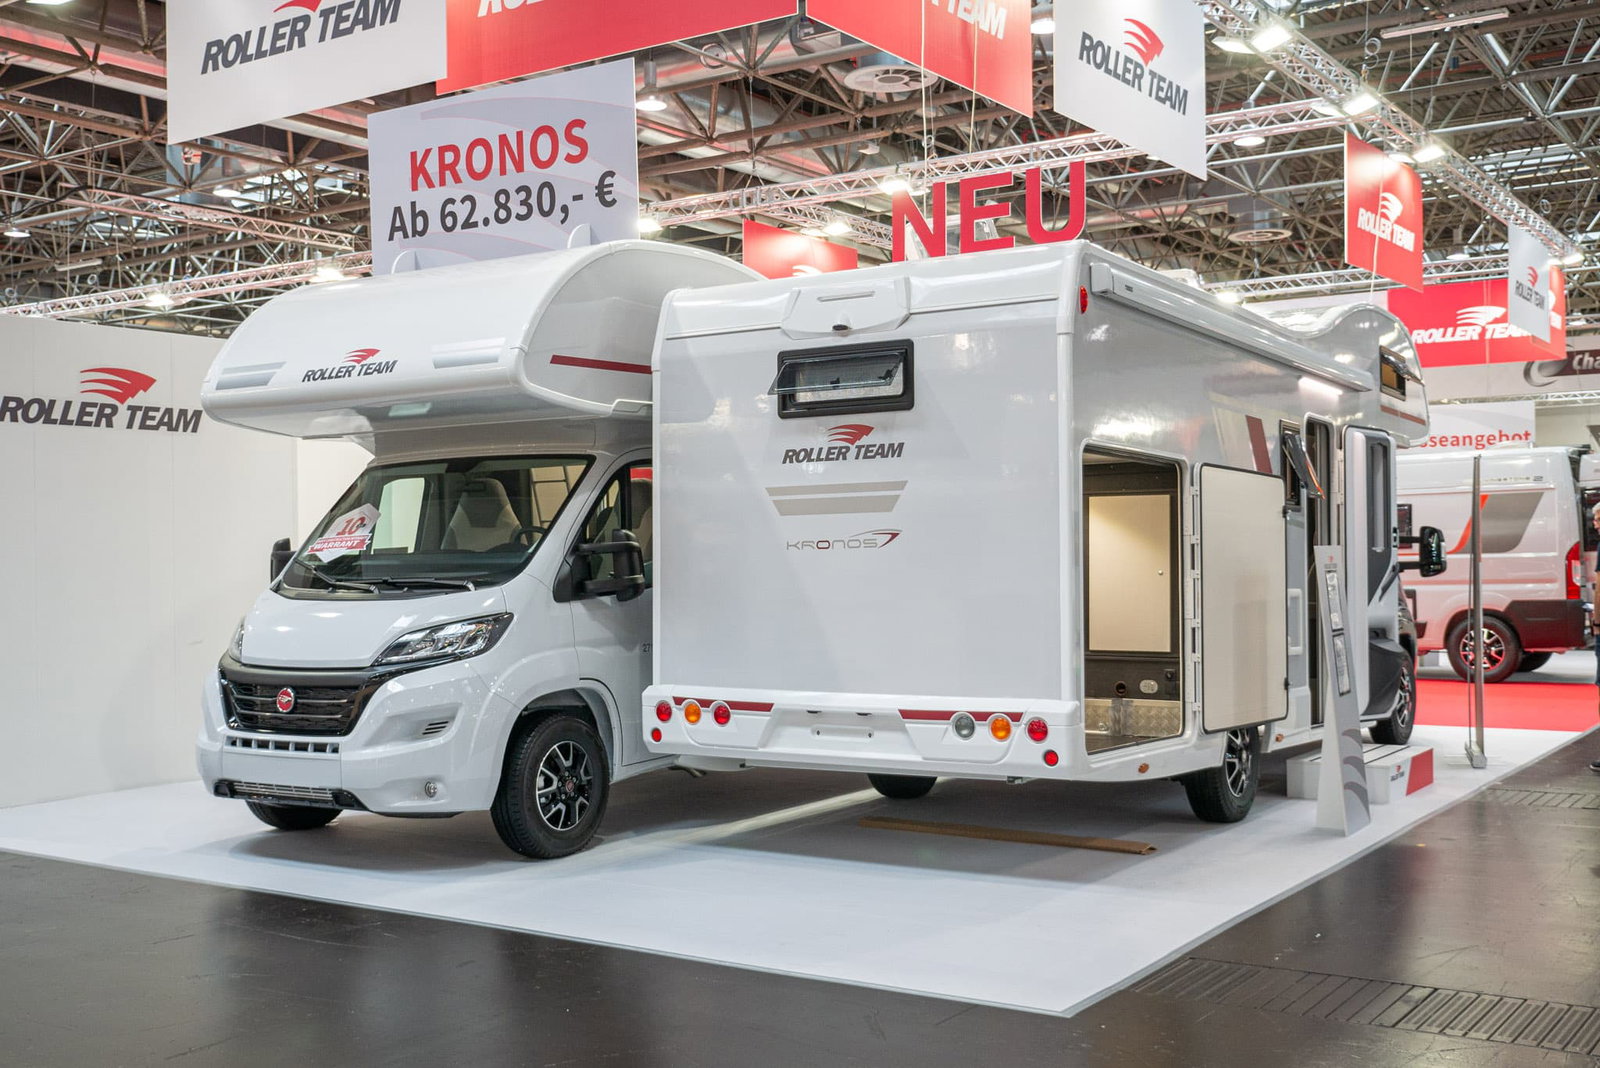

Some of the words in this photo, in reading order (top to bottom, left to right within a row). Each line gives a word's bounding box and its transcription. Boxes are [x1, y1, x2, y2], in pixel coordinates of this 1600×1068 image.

[201, 14, 311, 75] ROLLER
[318, 0, 401, 43] TEAM
[1079, 31, 1145, 92] ROLLER
[1148, 69, 1188, 116] TEAM
[410, 119, 589, 192] KRONOS
[388, 201, 429, 242] Ab
[595, 170, 617, 208] €
[891, 160, 1086, 262] NEU
[1357, 207, 1392, 242] ROLLER
[1411, 325, 1482, 344] ROLLER
[302, 365, 356, 382] ROLLER
[357, 360, 398, 376] TEAM
[0, 396, 118, 429] ROLLER
[126, 405, 203, 433] TEAM
[782, 446, 850, 464] ROLLER
[855, 442, 904, 460] TEAM
